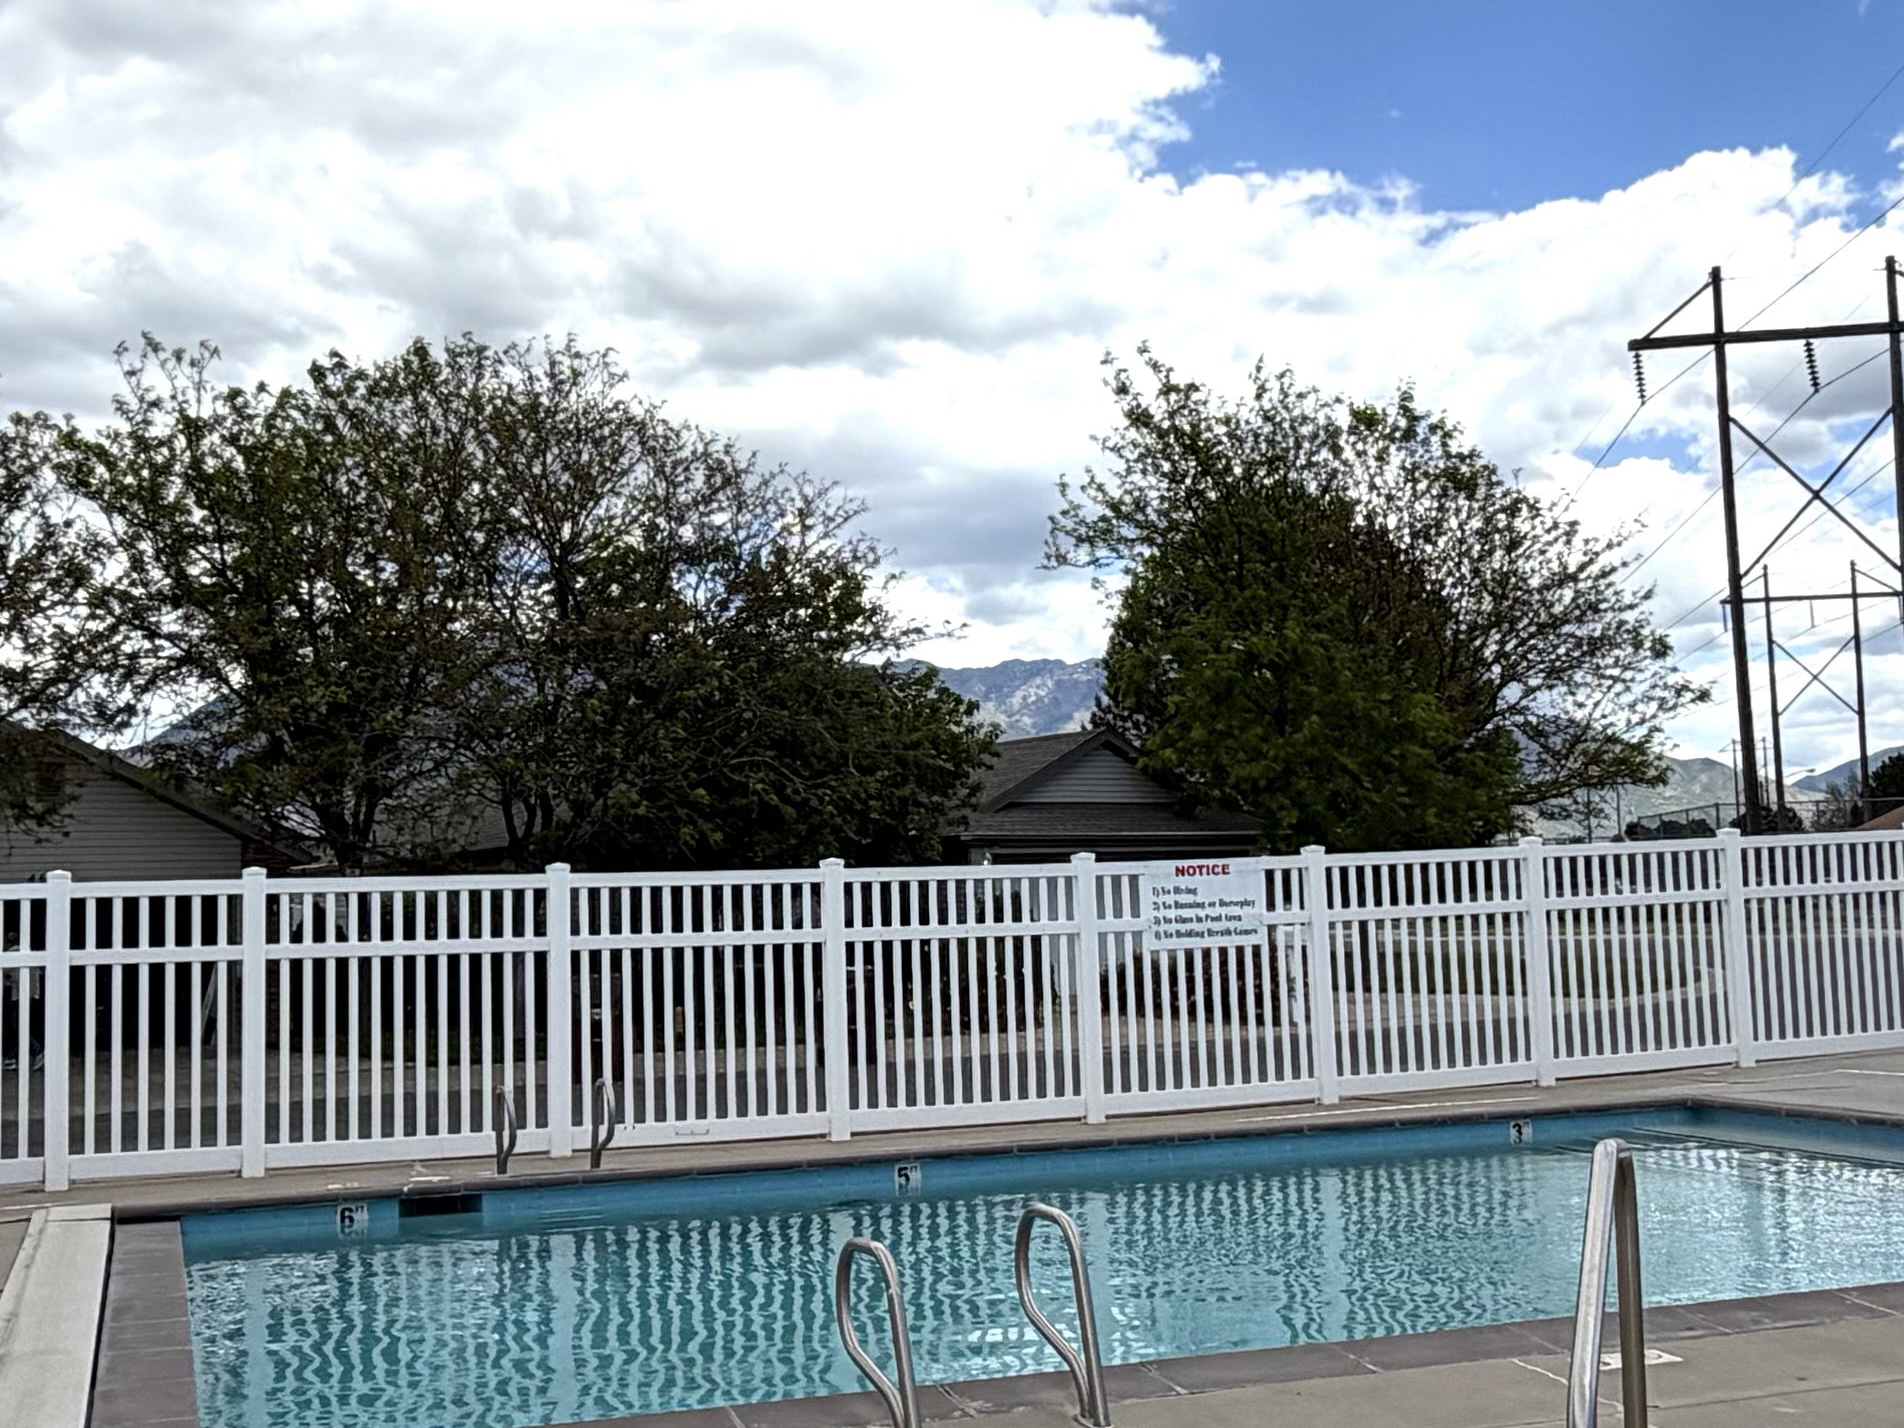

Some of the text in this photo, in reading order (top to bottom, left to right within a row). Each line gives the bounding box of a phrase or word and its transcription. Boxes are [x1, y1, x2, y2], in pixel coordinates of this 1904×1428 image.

[1174, 863, 1231, 877] NOTICE
[1205, 913, 1222, 922] Pool
[340, 1206, 355, 1229] 6
